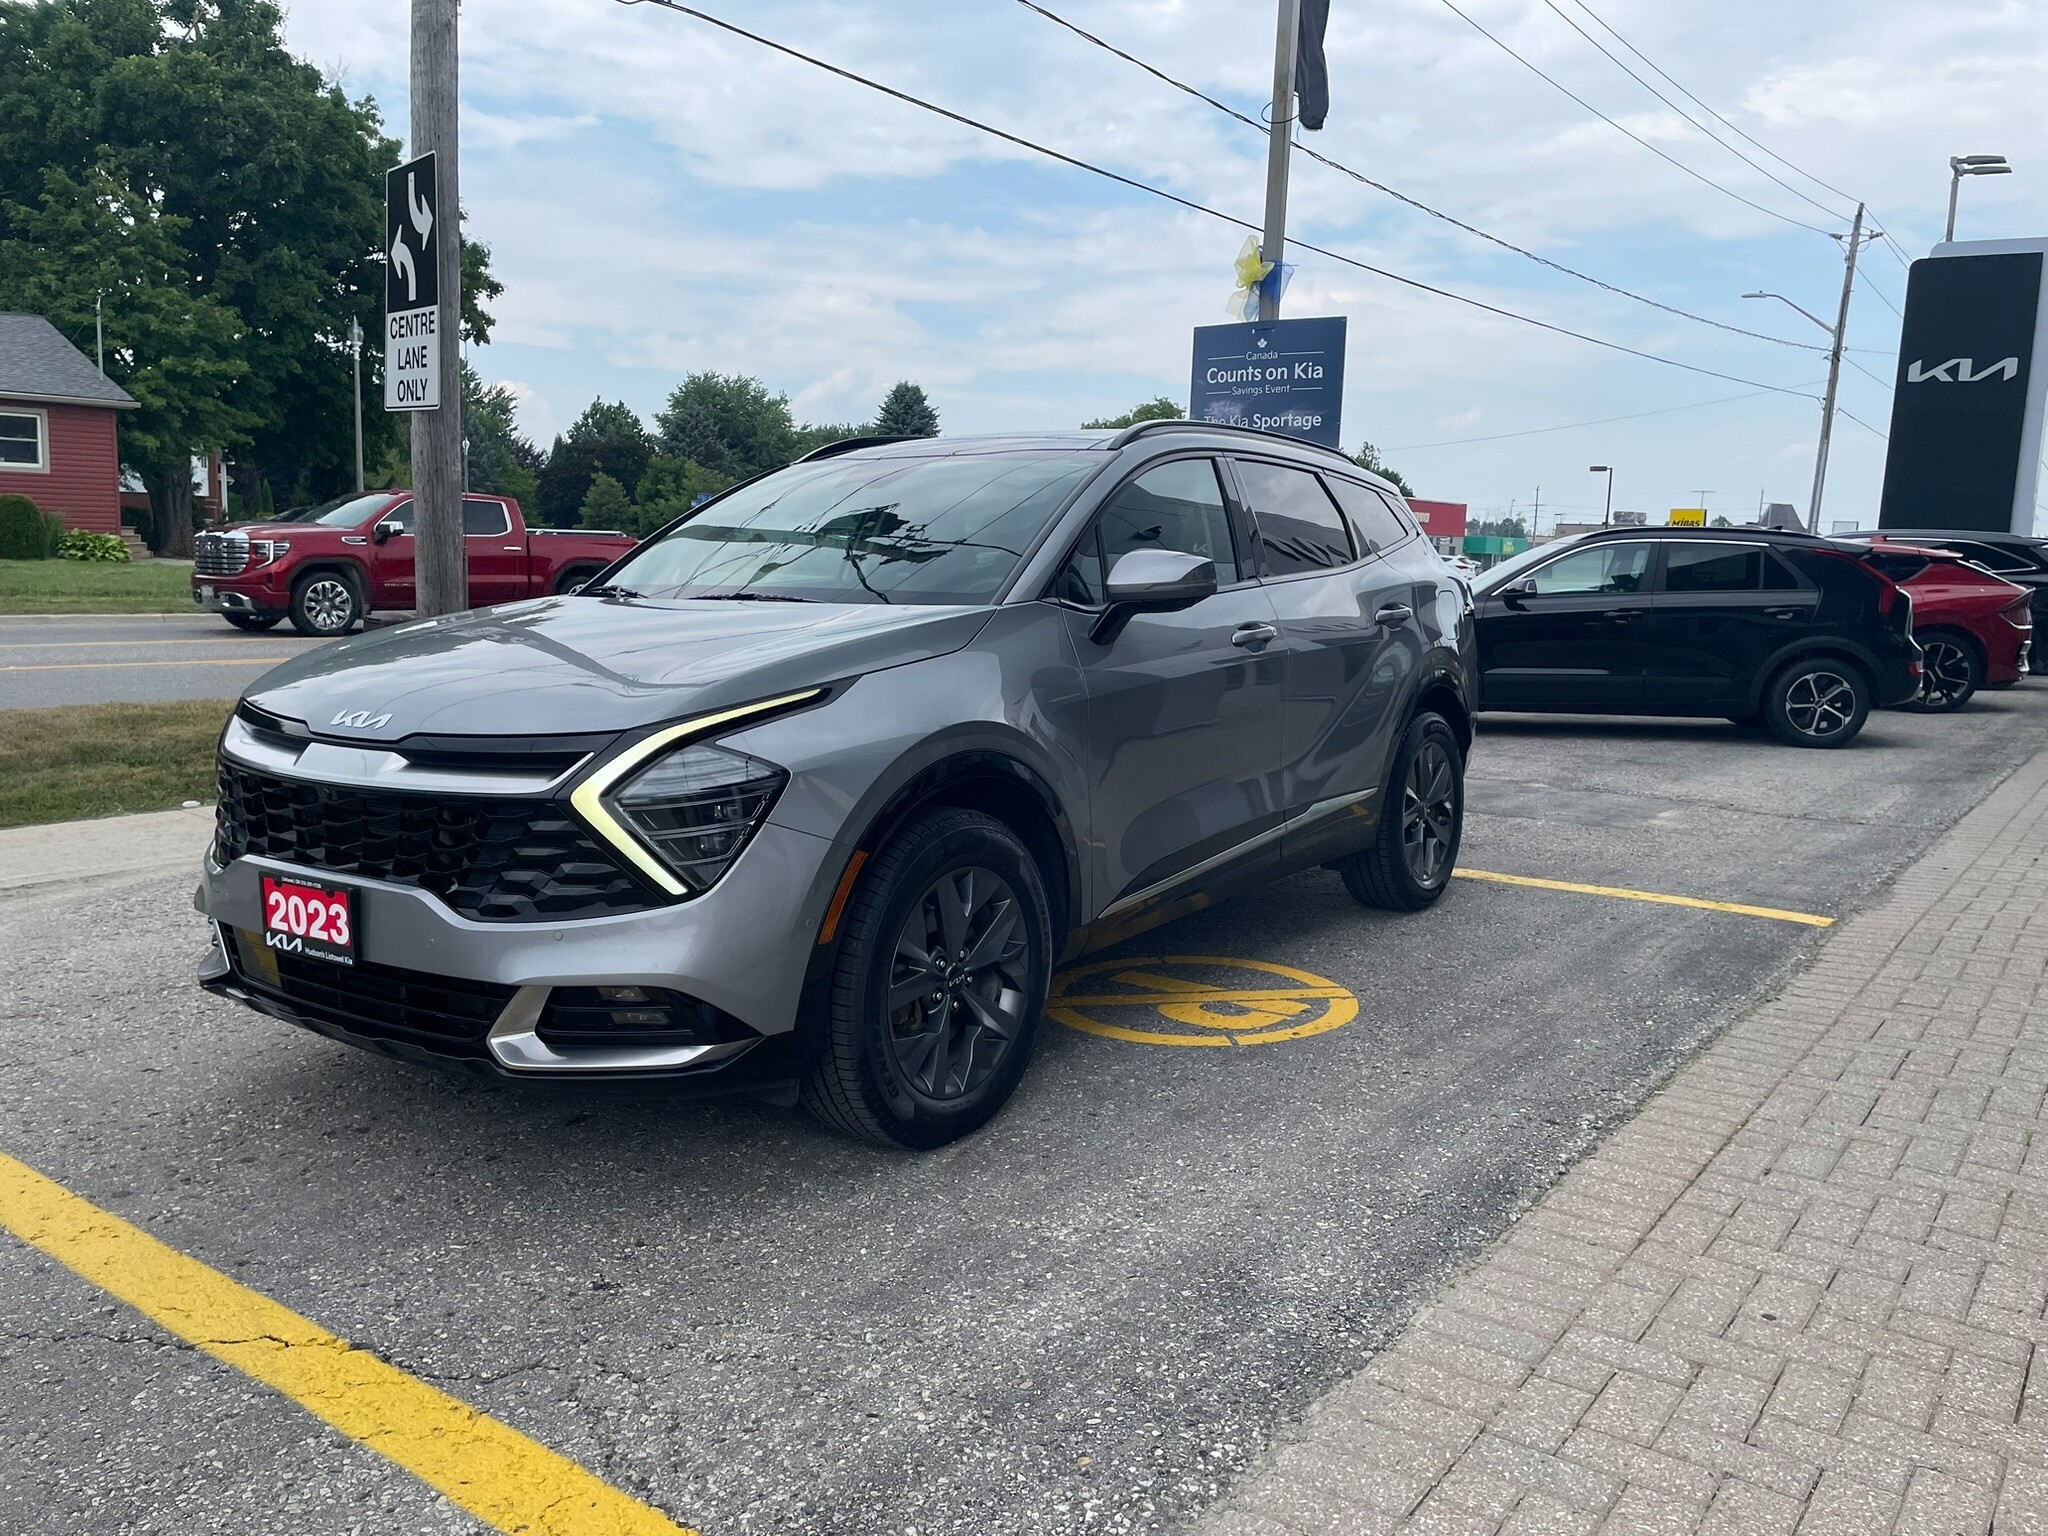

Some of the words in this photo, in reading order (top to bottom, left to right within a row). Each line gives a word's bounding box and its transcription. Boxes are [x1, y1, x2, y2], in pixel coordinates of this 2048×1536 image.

[390, 310, 435, 339] CENTRE
[398, 345, 427, 370] LANE
[1245, 350, 1278, 361] Canada
[1206, 366, 1262, 384] Counts
[1265, 367, 1288, 380] on
[1294, 362, 1323, 379] Kia
[1907, 357, 2018, 382] KIA
[397, 378, 428, 402] ONLY
[1231, 385, 1263, 396] Savings
[1265, 384, 1290, 394] Event
[1230, 414, 1249, 428] Kia
[1252, 413, 1322, 431] Sportage
[330, 709, 394, 731] KIA
[269, 891, 349, 945] 2023
[266, 931, 303, 953] KIA
